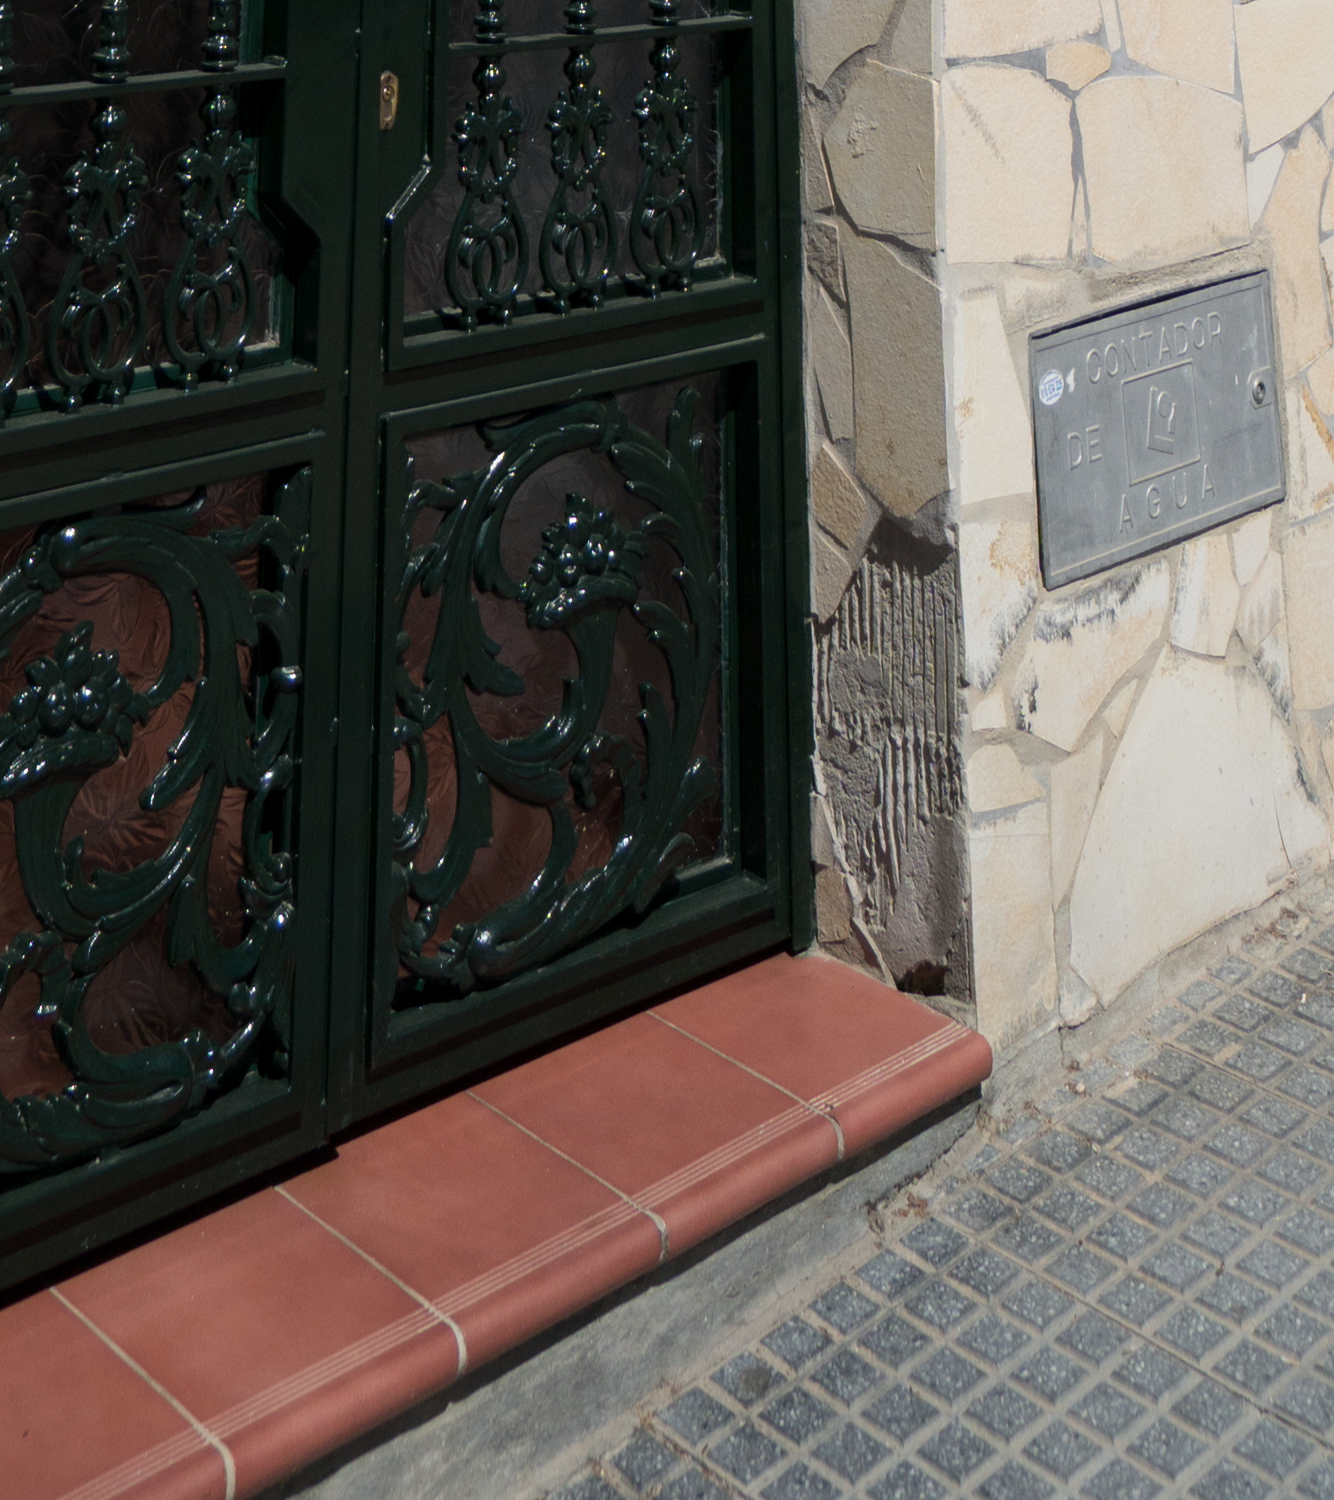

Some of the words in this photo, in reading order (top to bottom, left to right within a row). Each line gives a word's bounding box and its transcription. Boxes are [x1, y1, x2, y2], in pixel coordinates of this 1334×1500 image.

[1086, 311, 1223, 384] CONTADOR
[1067, 424, 1103, 470] DE
[1119, 464, 1216, 533] AGUA
